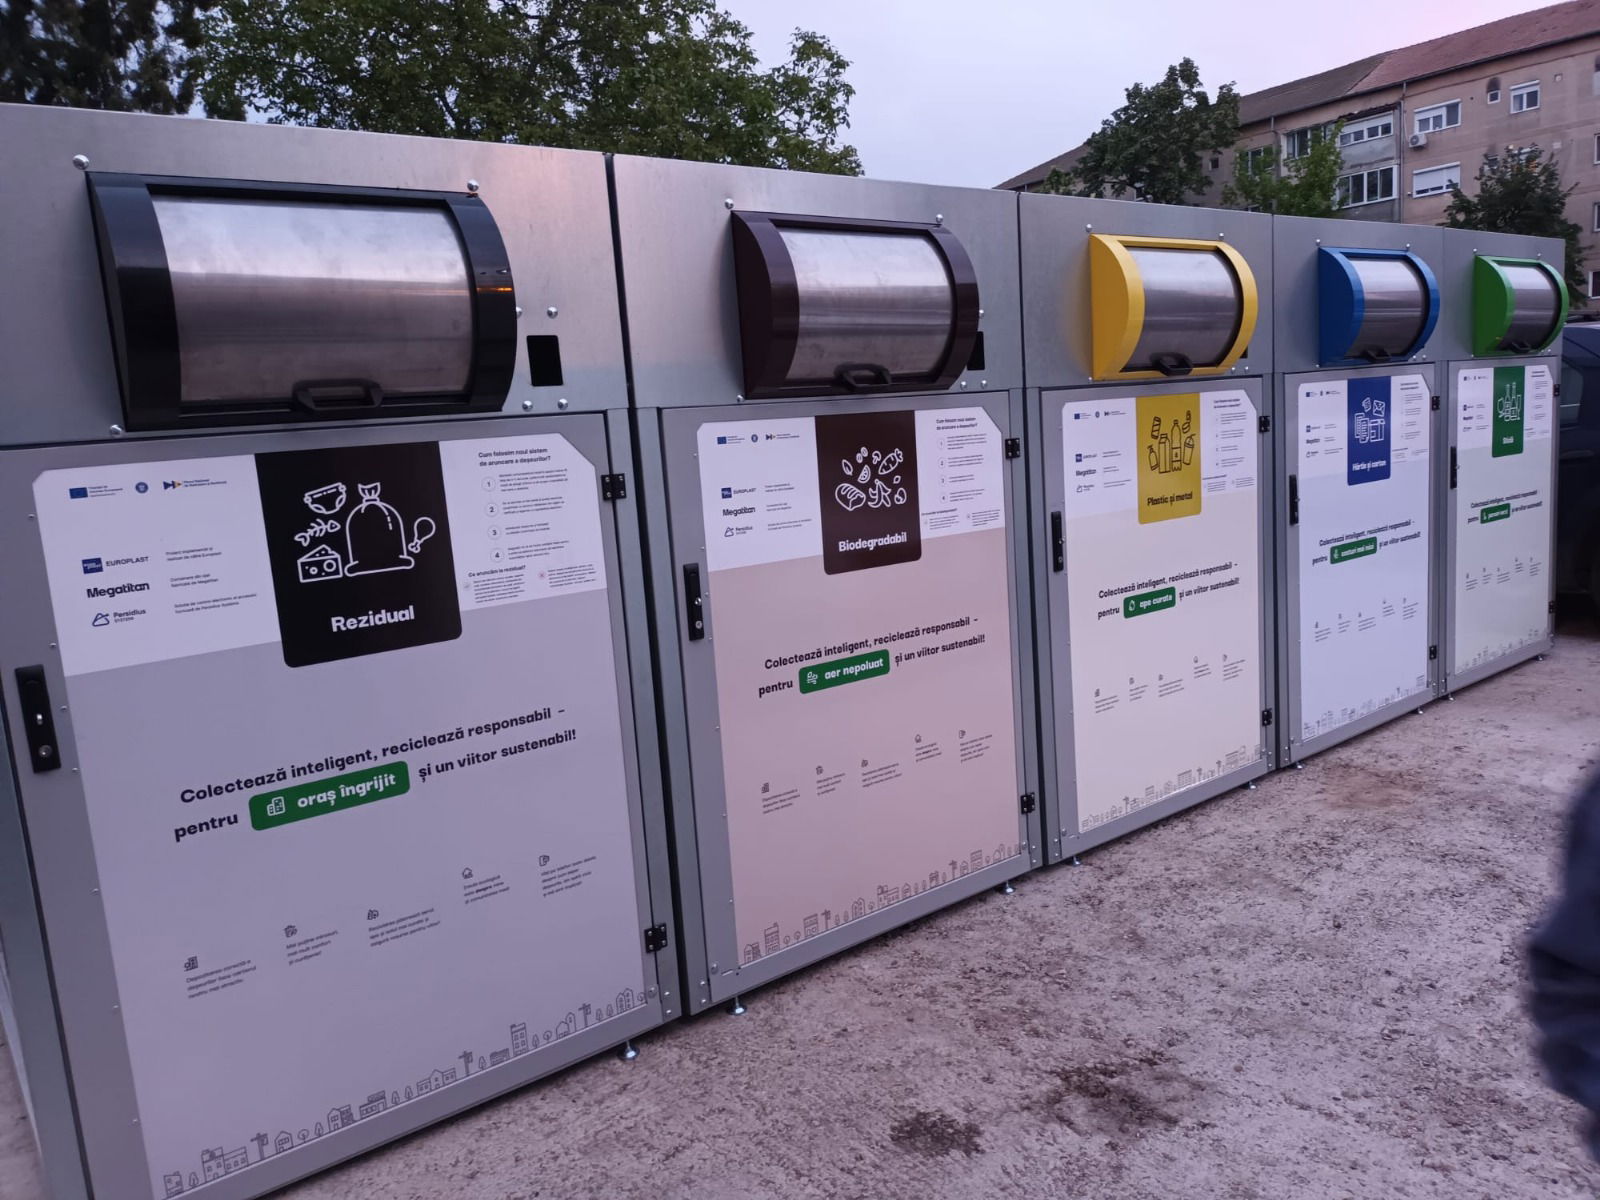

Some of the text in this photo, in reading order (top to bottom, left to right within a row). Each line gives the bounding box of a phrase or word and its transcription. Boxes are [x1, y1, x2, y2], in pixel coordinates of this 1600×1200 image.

[723, 506, 755, 516] Megatitan
[1147, 495, 1168, 506] Plastic
[838, 532, 907, 553] Biodegradabil
[106, 556, 149, 566] EUROPLAST
[87, 583, 150, 598] Megatitan
[113, 609, 146, 617] Persidius
[331, 605, 415, 632] Rezidual
[765, 648, 822, 669] Colectează
[824, 638, 872, 656] inteligent,
[874, 627, 920, 645] reciclează
[922, 616, 970, 635] responsabil
[758, 634, 985, 698] pentru aer nepoluat și un viitor sustenabil!
[180, 768, 287, 804] Colectează
[291, 748, 378, 779] inteligent,
[381, 727, 466, 757] reciclează
[467, 707, 551, 738] responsabil
[173, 729, 577, 842] pentru oraș îngrijit și un viitor sustenabil!
